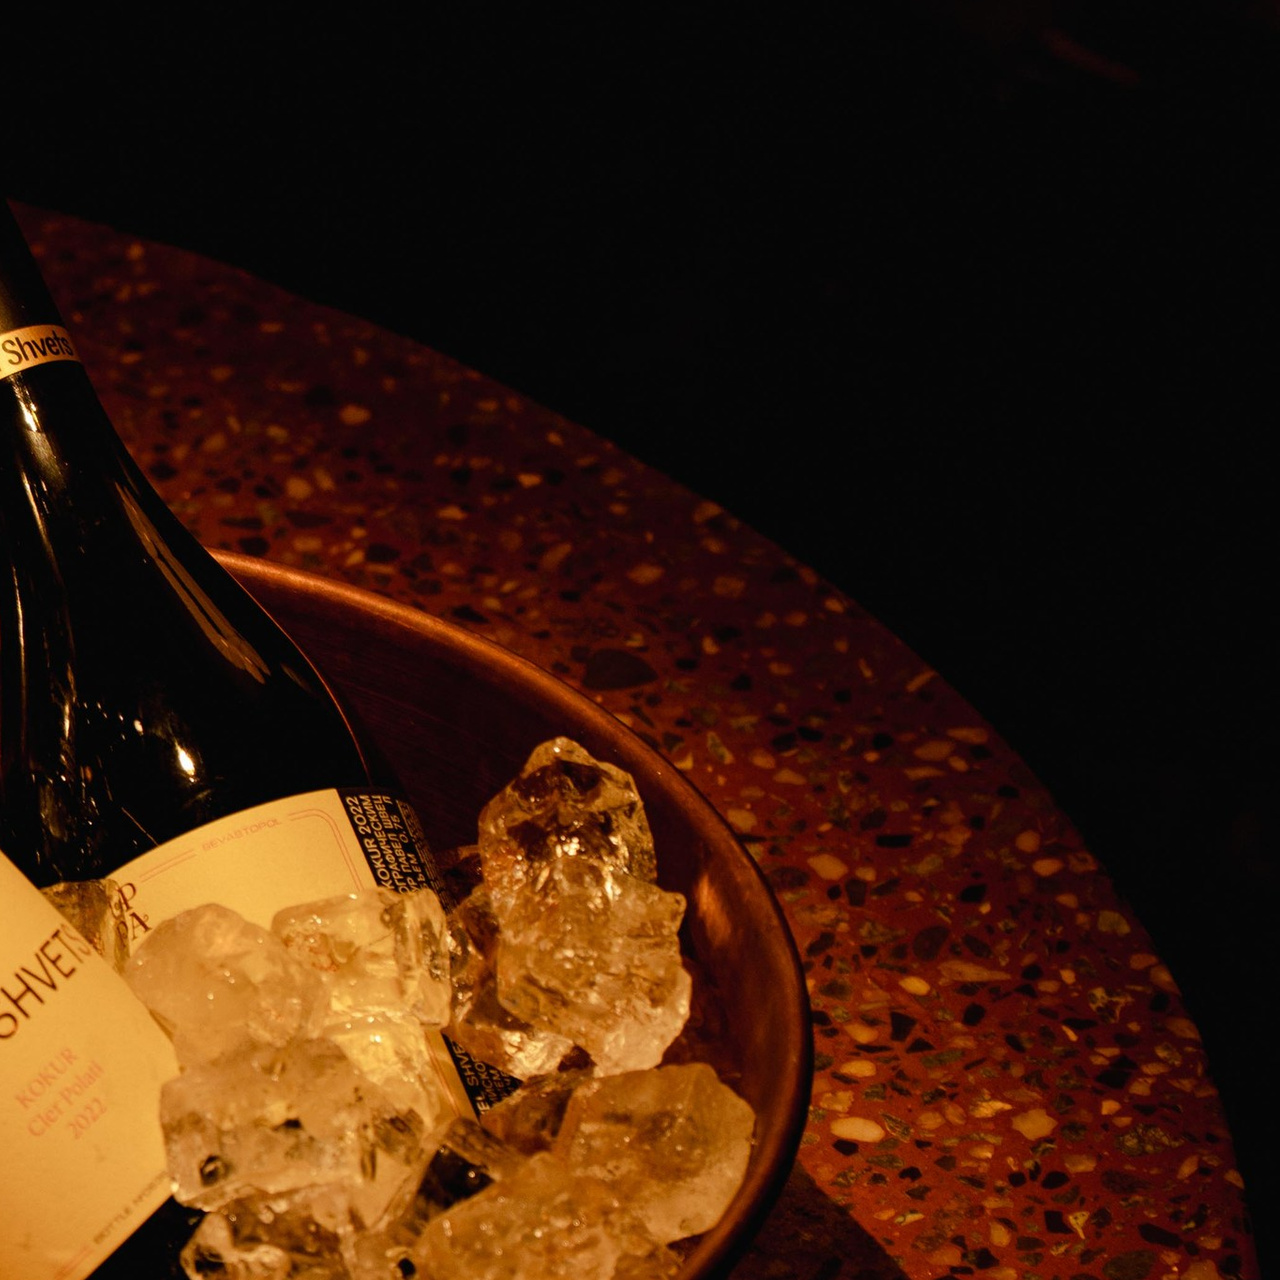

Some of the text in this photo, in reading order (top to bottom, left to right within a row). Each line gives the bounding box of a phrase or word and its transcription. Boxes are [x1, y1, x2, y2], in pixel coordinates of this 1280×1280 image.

[1, 330, 75, 366] Shvets
[371, 794, 394, 830] ШВЕЦ
[345, 795, 396, 889] KOKUR 2022
[387, 832, 412, 873] ПАВЕЛ
[14, 1047, 77, 1111] KOKUR
[451, 1039, 479, 1087] SHVE
[67, 1096, 108, 1140] 2022
